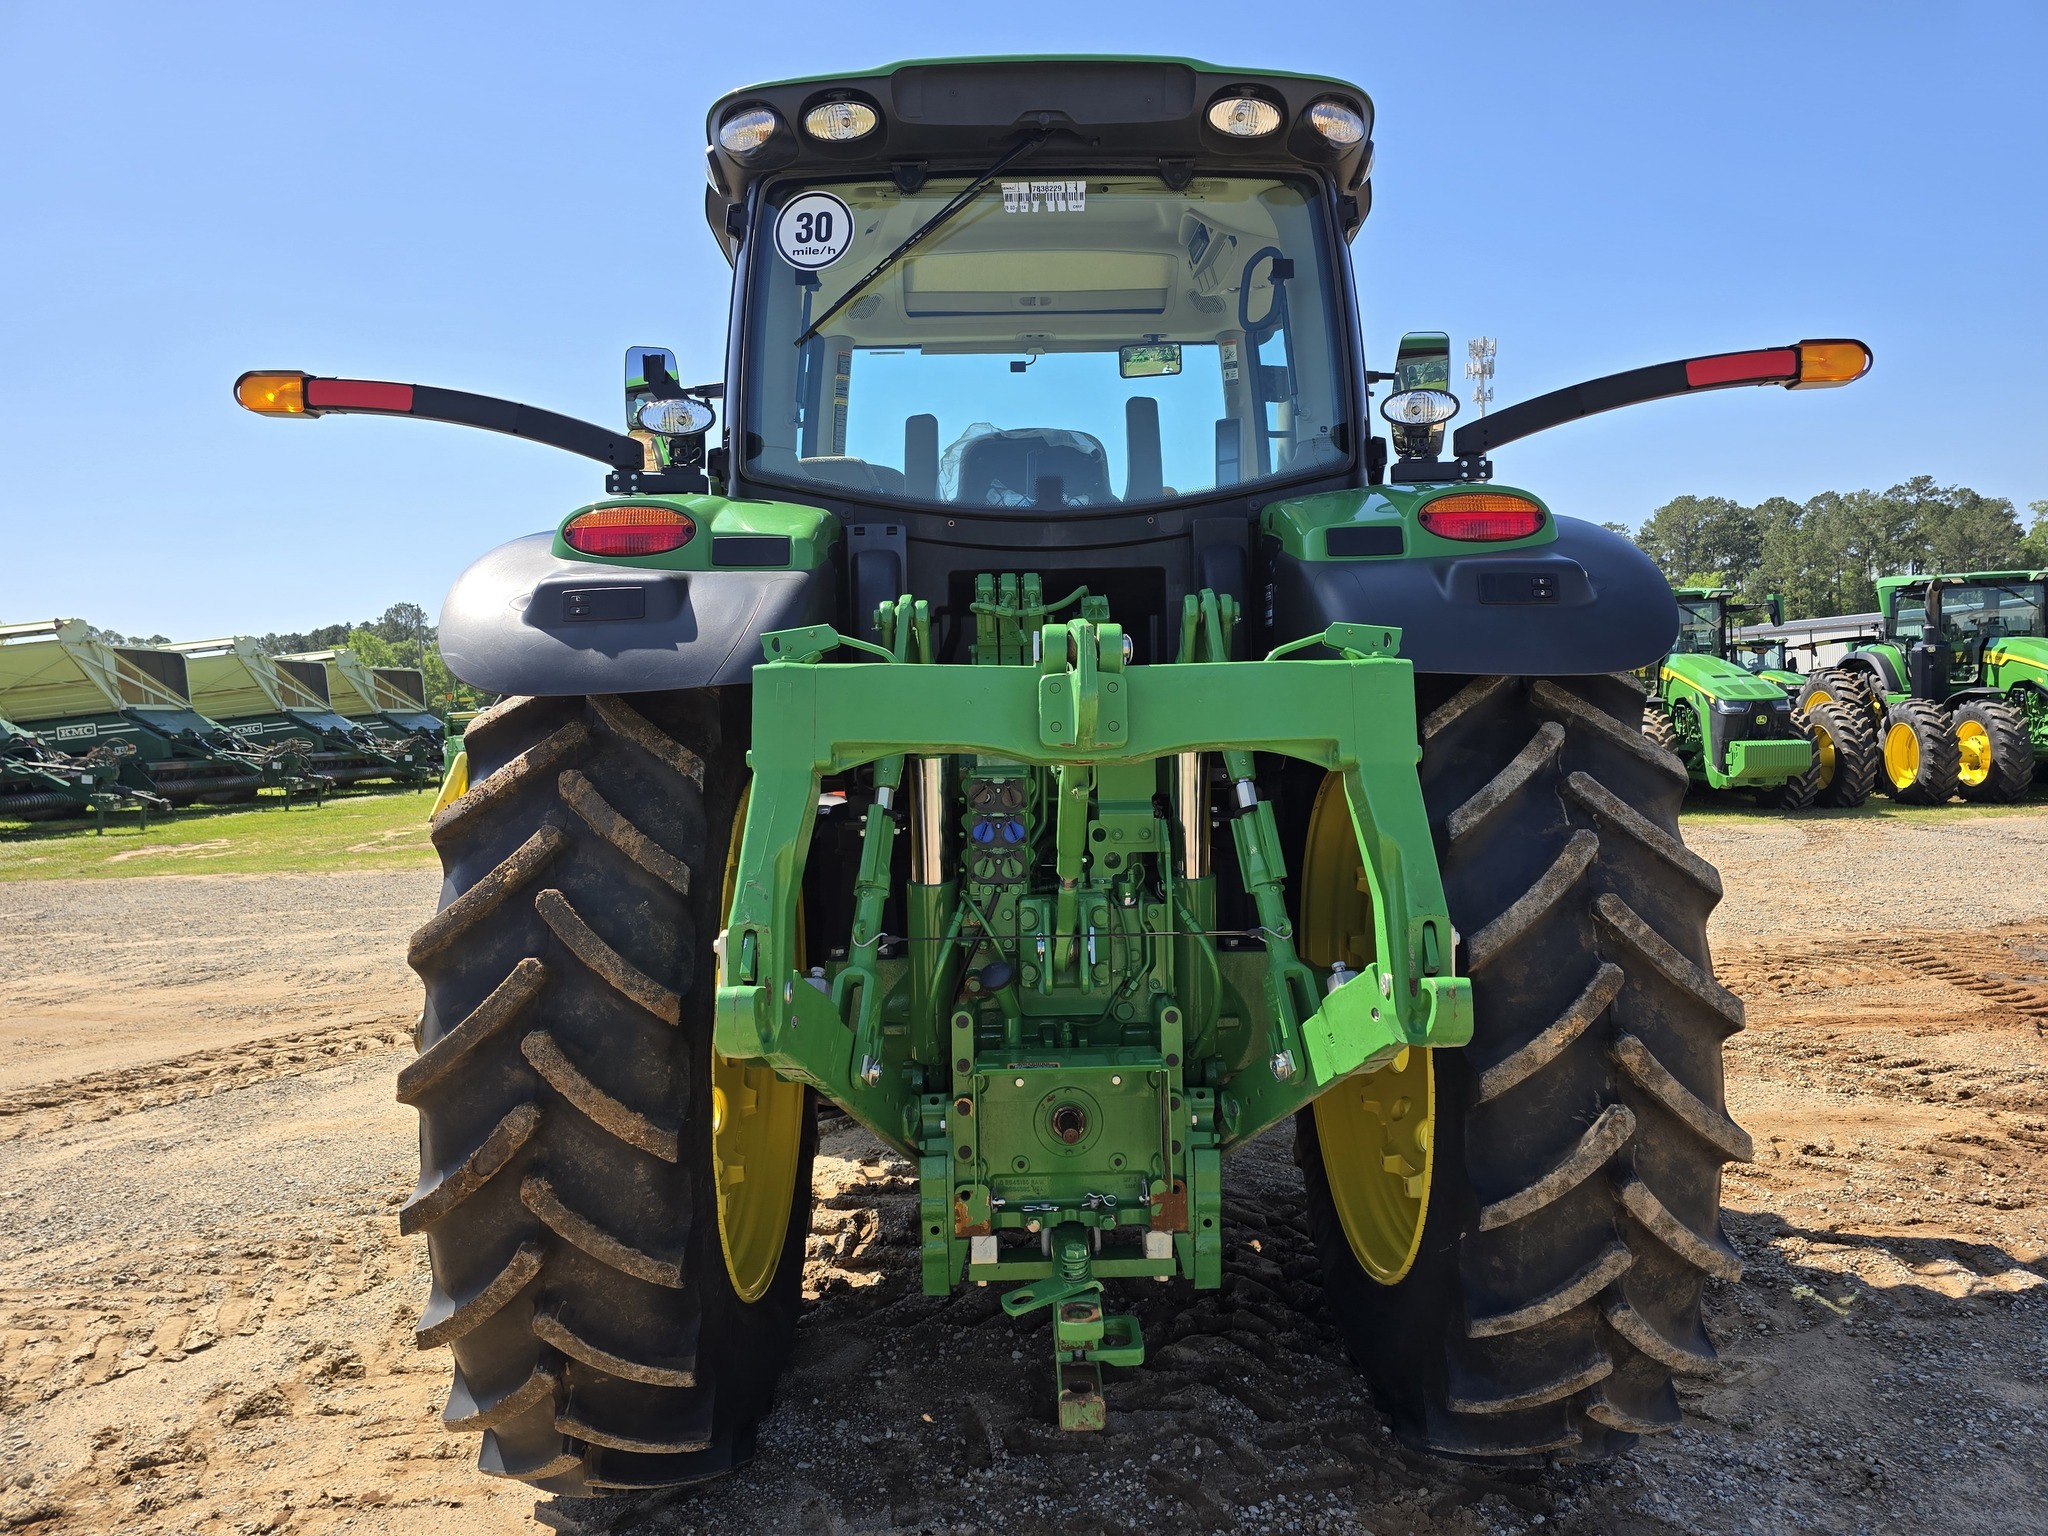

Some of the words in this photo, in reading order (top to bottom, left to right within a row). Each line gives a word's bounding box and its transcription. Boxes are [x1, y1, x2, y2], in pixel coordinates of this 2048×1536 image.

[795, 211, 833, 244] 30
[792, 246, 836, 256] mile/h
[60, 726, 93, 737] KMC
